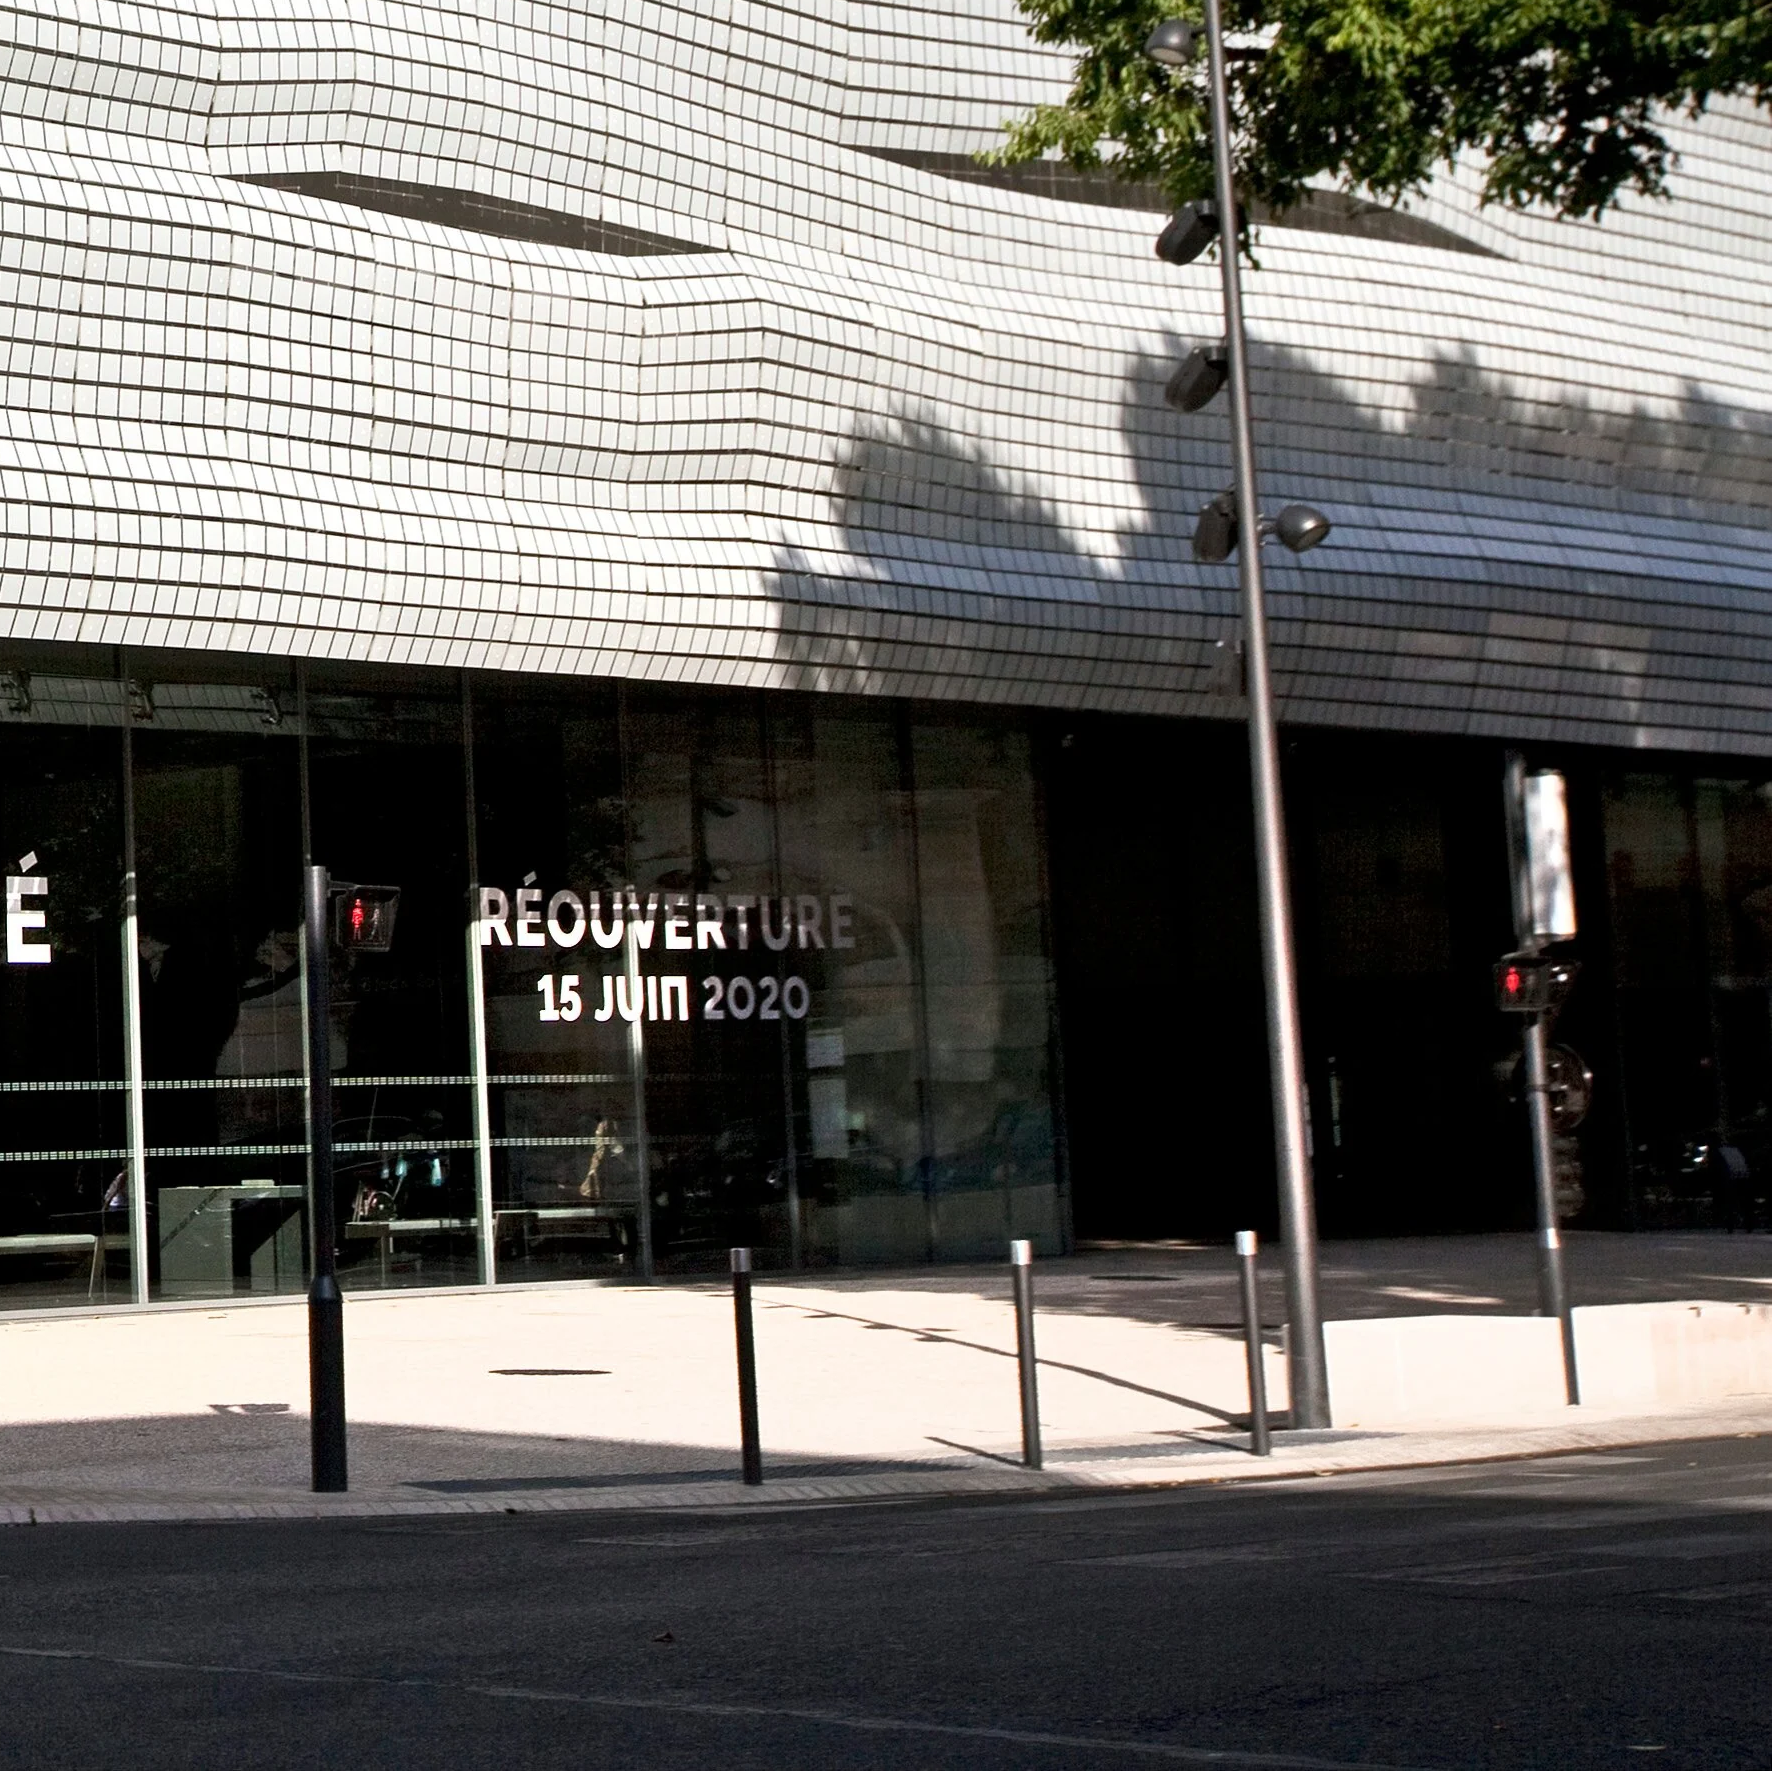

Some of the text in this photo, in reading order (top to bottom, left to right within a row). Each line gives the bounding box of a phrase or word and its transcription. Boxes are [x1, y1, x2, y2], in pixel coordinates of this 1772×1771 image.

[478, 871, 857, 951] RÉOUVERTURE
[537, 974, 811, 1022] 15 JUIN 2020
